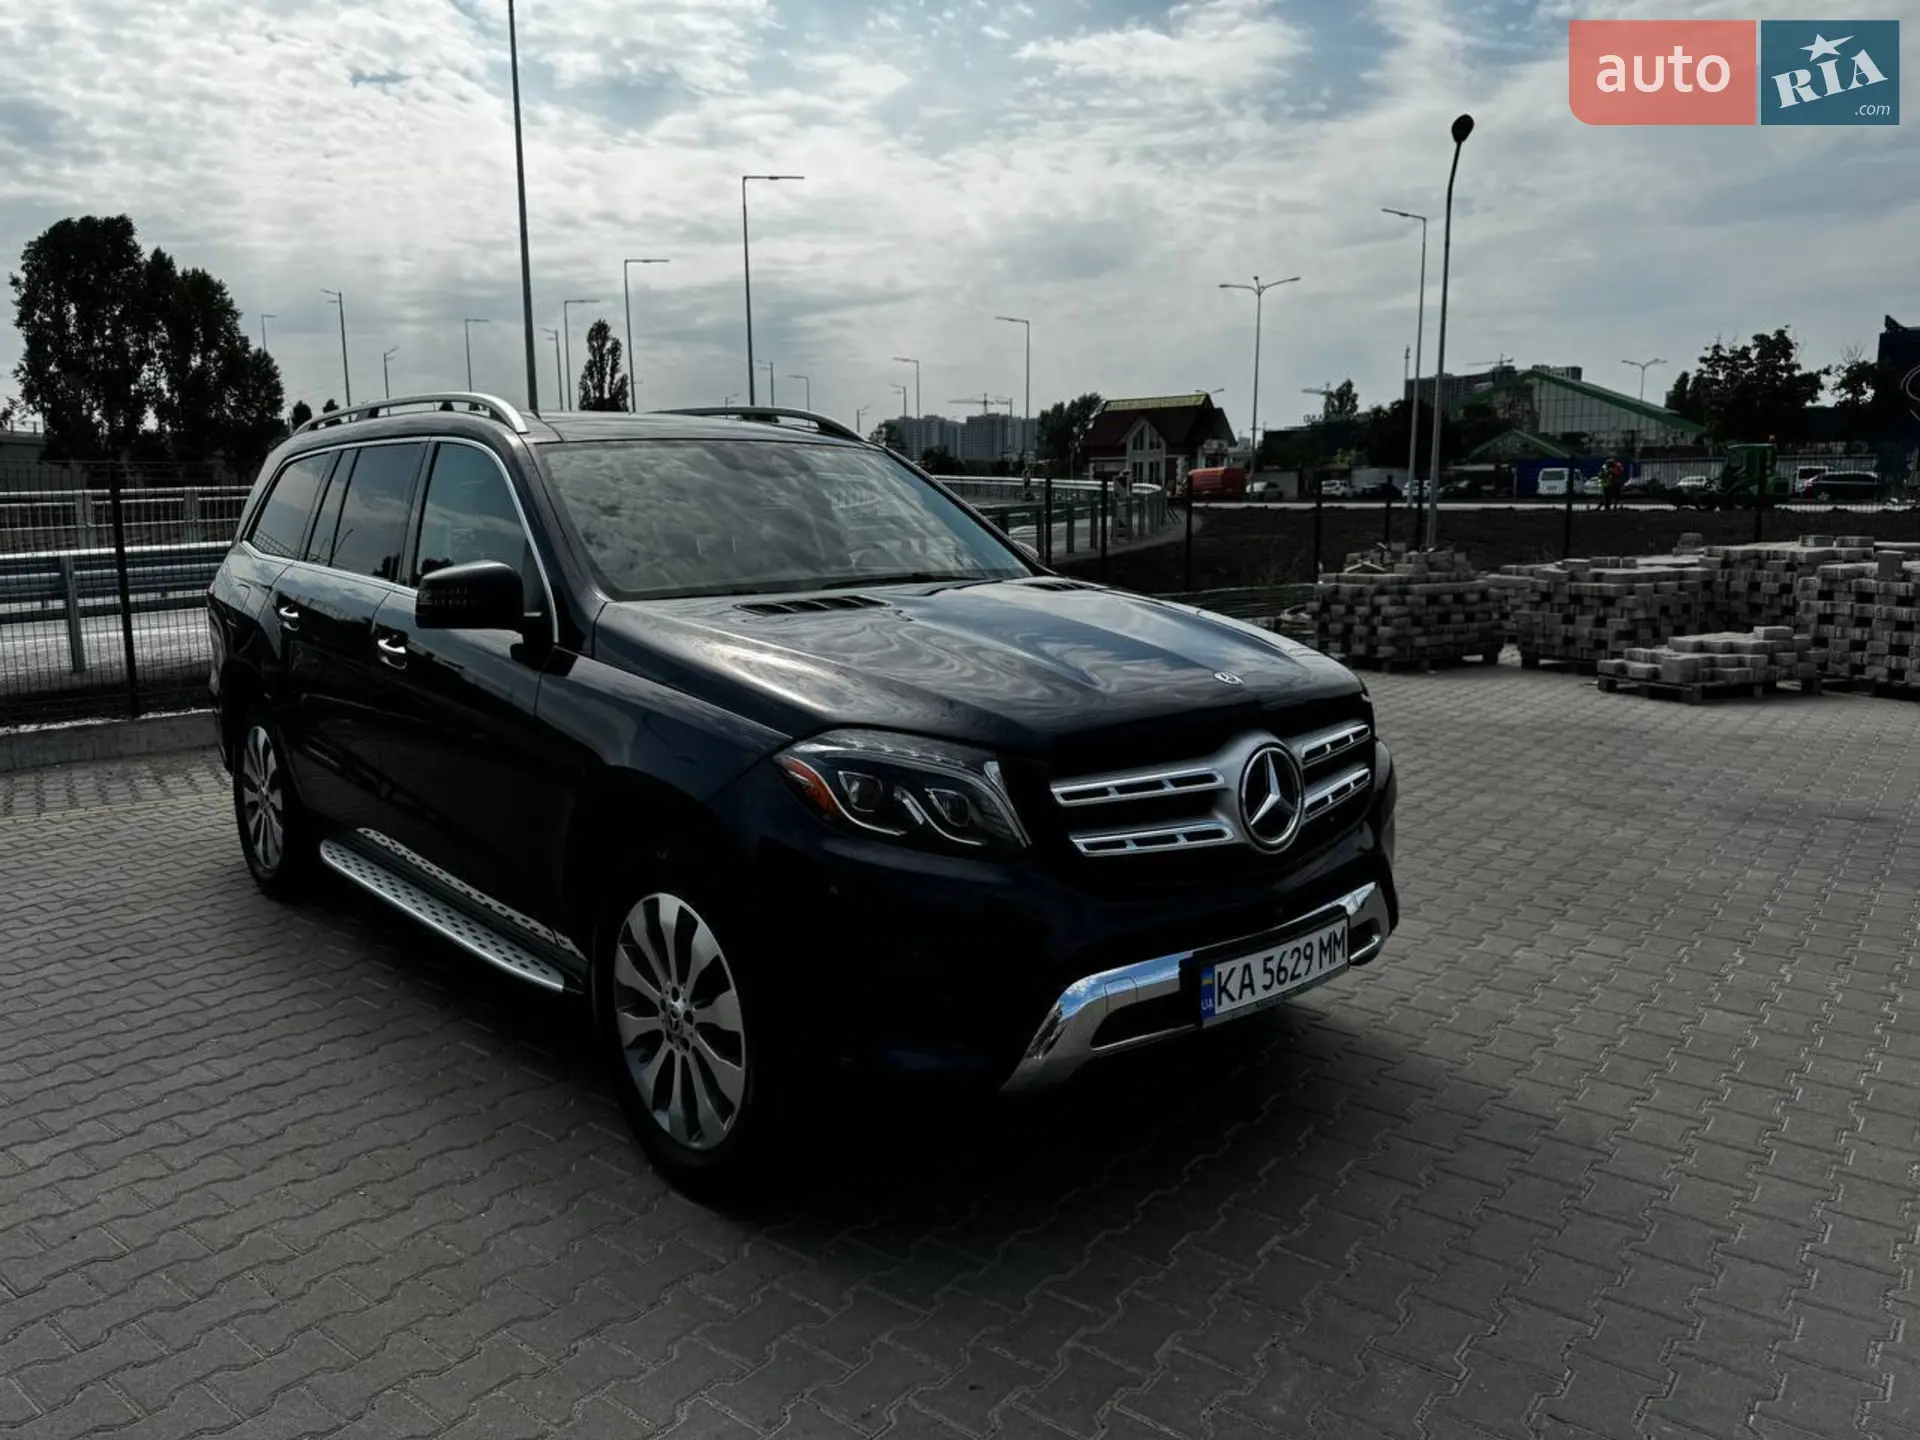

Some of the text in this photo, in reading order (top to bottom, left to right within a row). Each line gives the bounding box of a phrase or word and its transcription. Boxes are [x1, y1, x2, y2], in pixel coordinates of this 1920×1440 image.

[1217, 926, 1346, 1006] KA 5629 MM
[1201, 997, 1214, 1010] UA
